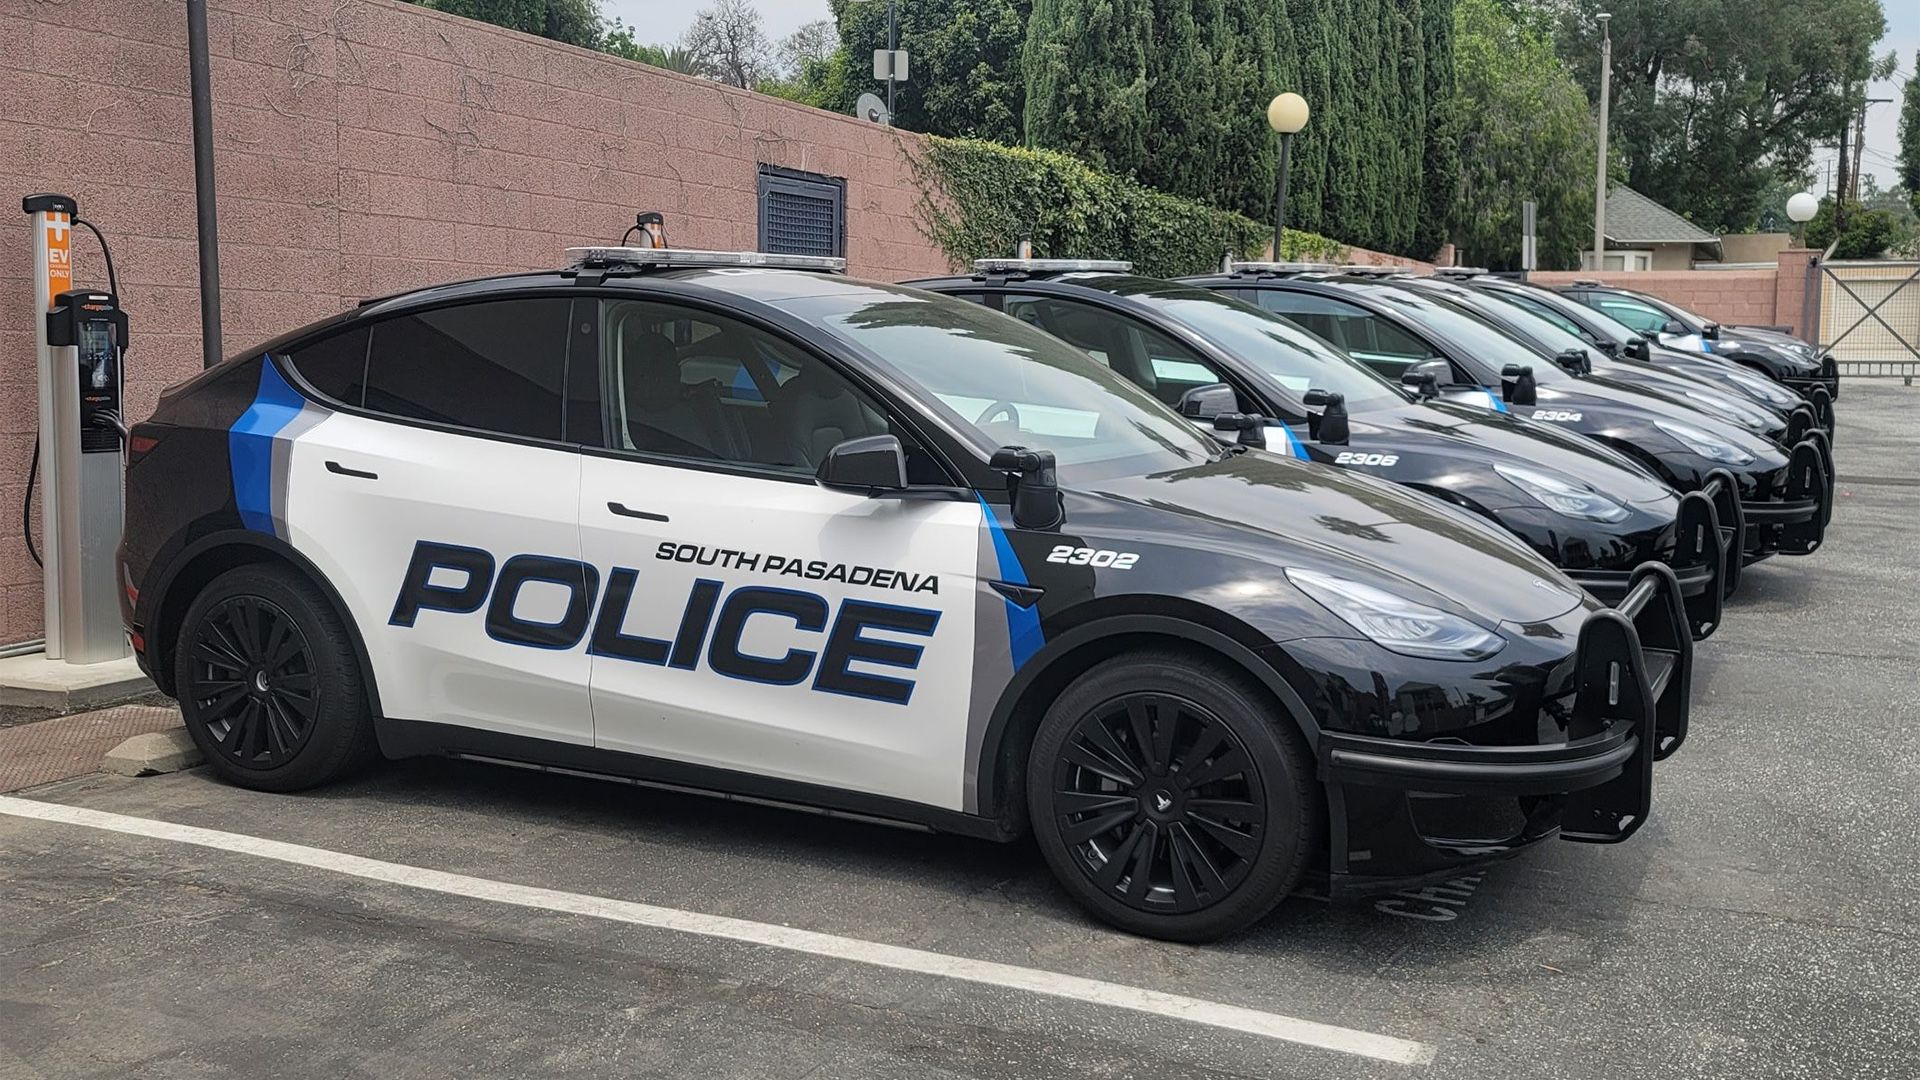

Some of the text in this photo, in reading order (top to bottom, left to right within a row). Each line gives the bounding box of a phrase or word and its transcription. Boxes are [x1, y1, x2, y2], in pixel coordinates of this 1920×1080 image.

[49, 248, 69, 264] EV
[49, 269, 70, 278] ONLY
[1531, 410, 1583, 422] 2304
[1334, 452, 1400, 467] 2306
[1046, 545, 1140, 570] 2302
[655, 541, 939, 595] SOUTH PASADENA
[387, 539, 943, 706] POLICE
